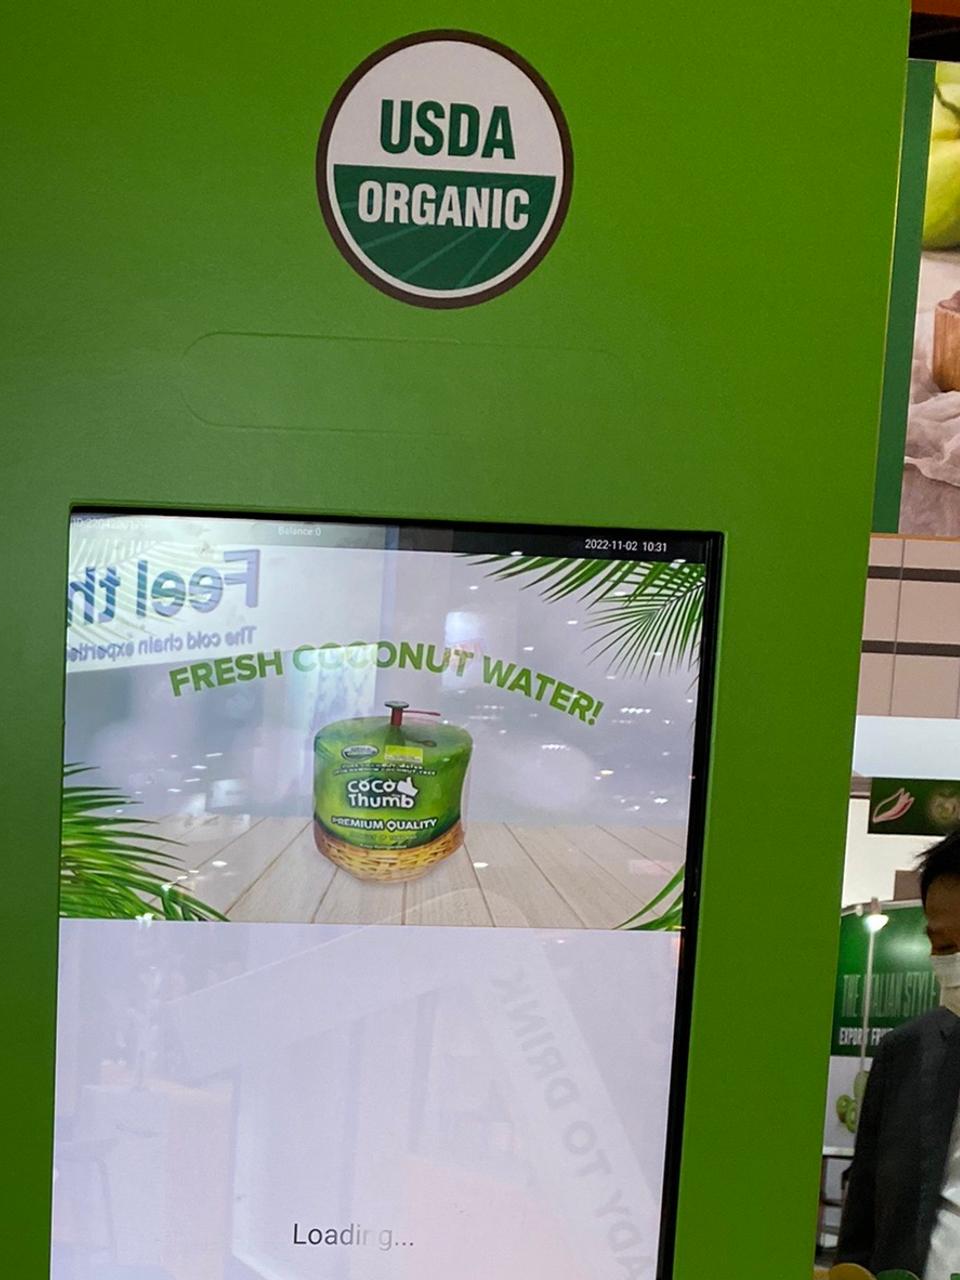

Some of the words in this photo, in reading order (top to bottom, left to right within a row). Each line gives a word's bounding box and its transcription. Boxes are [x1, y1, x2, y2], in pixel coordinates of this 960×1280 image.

[380, 99, 515, 160] USDA
[358, 180, 529, 230] ORGANIC
[585, 538, 638, 551] 2022-11-02
[643, 541, 667, 552] 10:31
[169, 648, 284, 697] FRESH
[292, 641, 474, 678] COCONUT
[482, 656, 605, 726] WATER!
[347, 793, 414, 808] Thumb
[332, 817, 383, 829] PREMIUM
[387, 818, 437, 831] QUALITY
